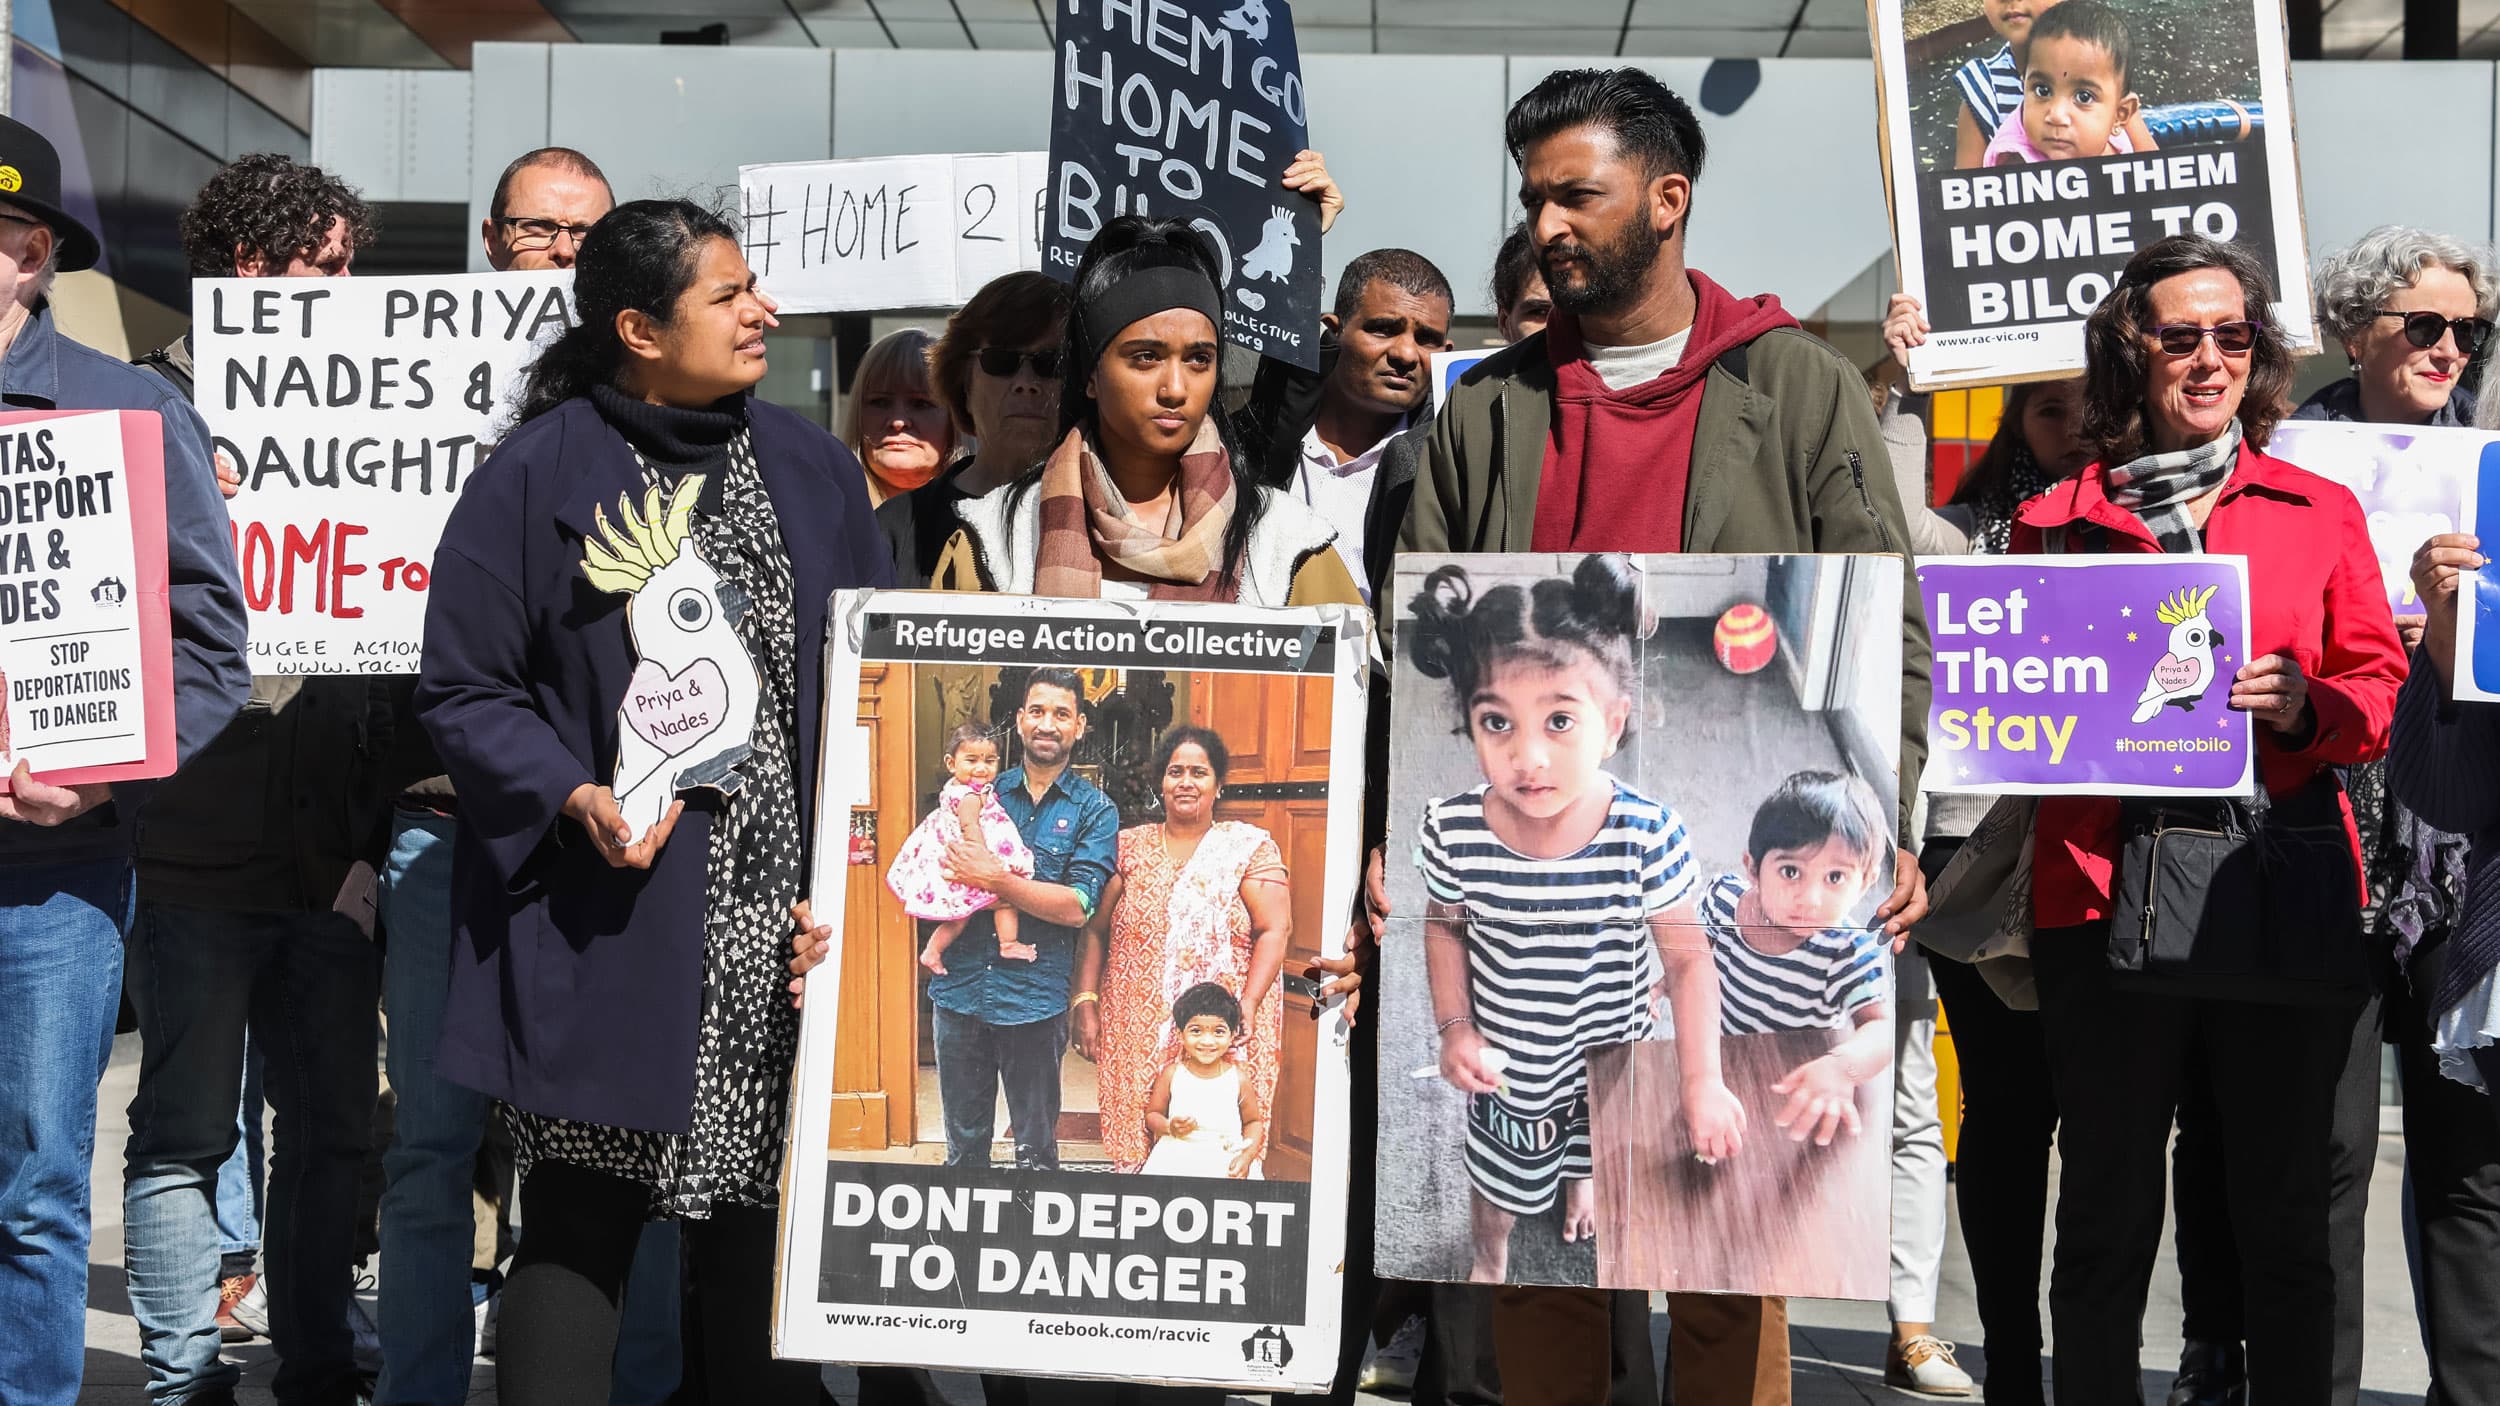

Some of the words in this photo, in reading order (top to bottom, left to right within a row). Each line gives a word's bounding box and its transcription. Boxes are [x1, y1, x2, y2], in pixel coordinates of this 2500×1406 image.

[1068, 0, 1232, 89] HEM
[1251, 56, 1306, 127] GO
[1065, 40, 1271, 188] HOME
[1115, 143, 1203, 200] TO
[1941, 167, 2089, 211] BRING
[2103, 152, 2237, 195] THEM
[962, 184, 1005, 241] 2
[1059, 161, 1233, 290] BIO
[1950, 211, 2135, 268] HOME
[2152, 202, 2238, 243] TO
[213, 287, 331, 338] LET
[385, 286, 572, 341] PRIYA
[1968, 271, 2123, 324] BILO
[1225, 326, 1263, 351] .org
[1936, 330, 2039, 347] www.rac-vic.org
[225, 353, 434, 410] NADES
[463, 361, 495, 415] &
[211, 434, 493, 496] DAUGHT
[0, 471, 113, 526] DEPORT
[47, 528, 71, 570] &
[230, 518, 368, 618] OME
[378, 556, 430, 592] TO
[0, 578, 61, 625] DES
[1936, 587, 2029, 635] Let
[50, 641, 90, 666] STOP
[895, 619, 1026, 656] Refugee
[1032, 623, 1135, 654] Action
[1143, 625, 1303, 659] Collective
[13, 668, 131, 702] DEPORTATIONS
[1936, 647, 2109, 694] Them
[2160, 666, 2182, 675] Priya
[2183, 665, 2190, 673] &
[2161, 677, 2187, 685] Nades
[29, 708, 49, 731] TO
[54, 700, 118, 727] DANGER
[635, 686, 684, 714] Priya
[688, 679, 703, 697] &
[650, 711, 709, 741] Nades
[1938, 706, 2079, 765] Stay
[2115, 736, 2231, 753] #hometobilo
[1489, 1100, 1557, 1152] KIND
[831, 1181, 1012, 1234] DONT
[1031, 1190, 1296, 1248] DEPORT
[869, 1242, 955, 1292] TO
[977, 1247, 1248, 1306] DANGER
[825, 1310, 968, 1334] www.rac-vic.org
[1027, 1319, 1211, 1344] facebook.com/racvic
